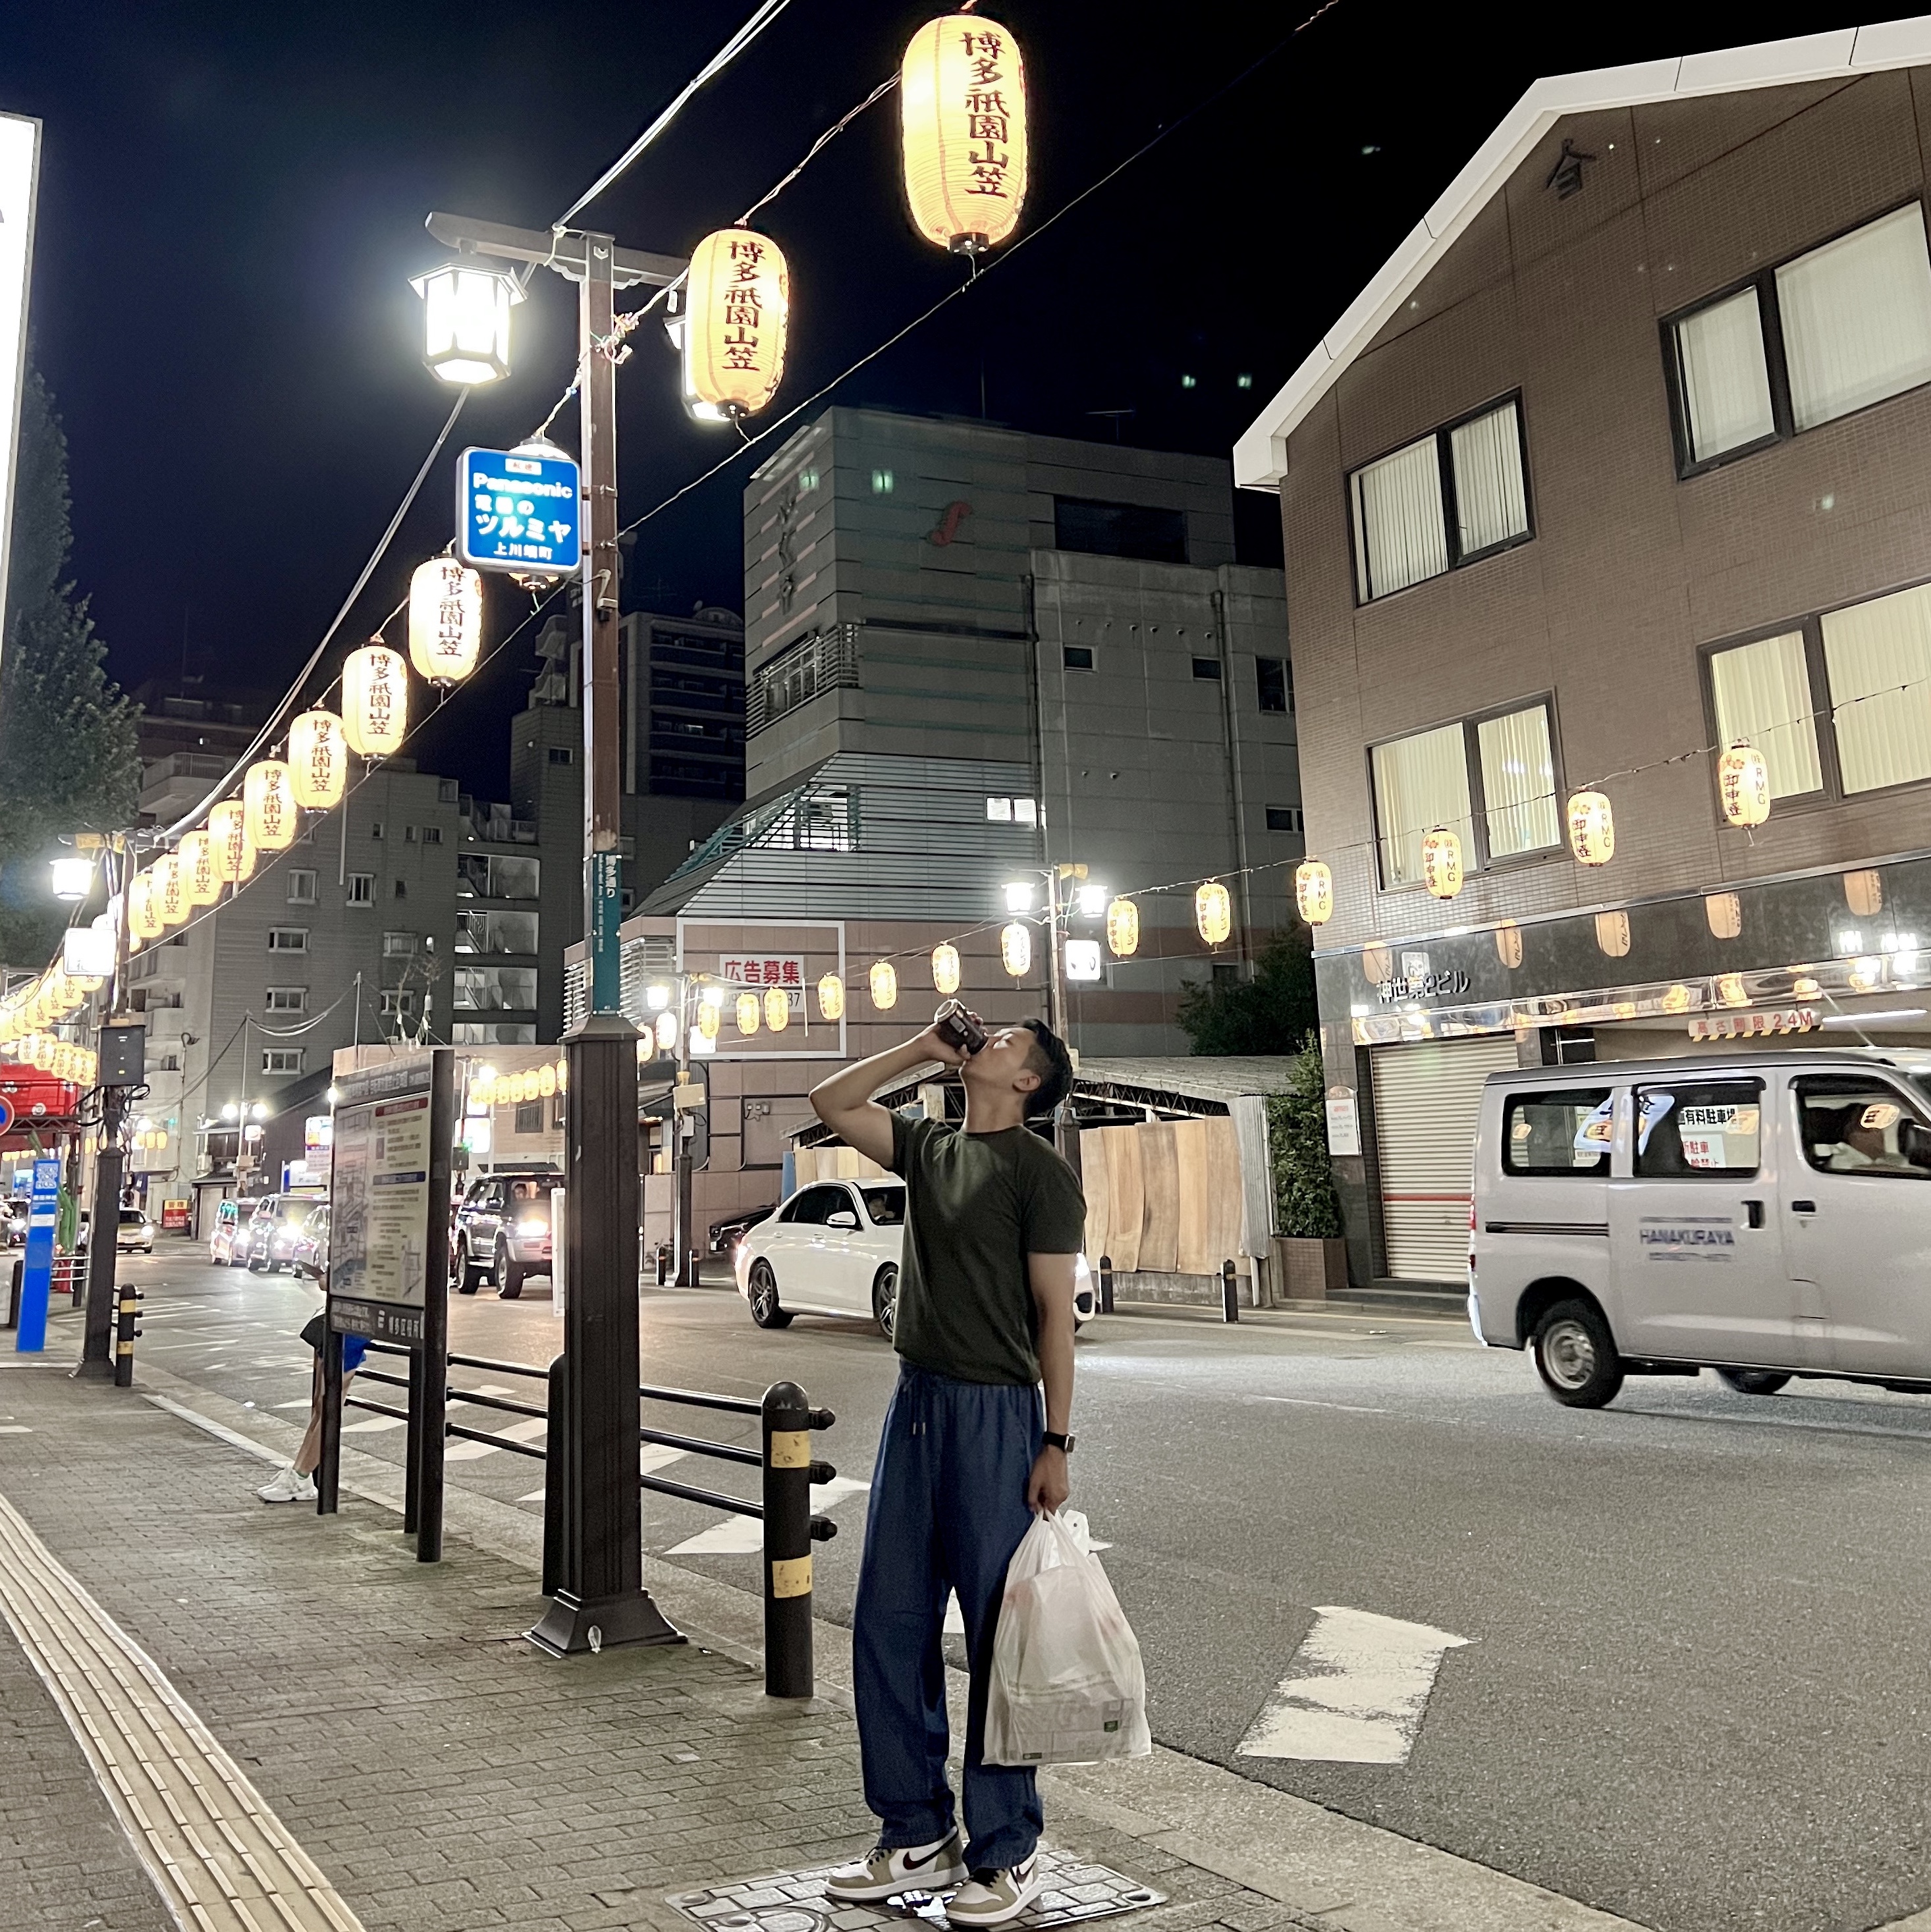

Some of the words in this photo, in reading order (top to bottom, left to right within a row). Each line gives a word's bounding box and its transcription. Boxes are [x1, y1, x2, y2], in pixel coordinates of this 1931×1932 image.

[959, 31, 1010, 198] 博多祇園山笠
[722, 241, 766, 371] 博多祇園山笠
[475, 514, 572, 543] ツルミヤ
[436, 566, 466, 657] 博多祇園山笠
[367, 653, 393, 736] 博多祇園山笠
[310, 719, 332, 792] 博多祇園山笠
[262, 769, 283, 836] 博多祇園山笠
[725, 960, 800, 984] 広告募集
[1679, 1108, 1735, 1125] 有料駐車場
